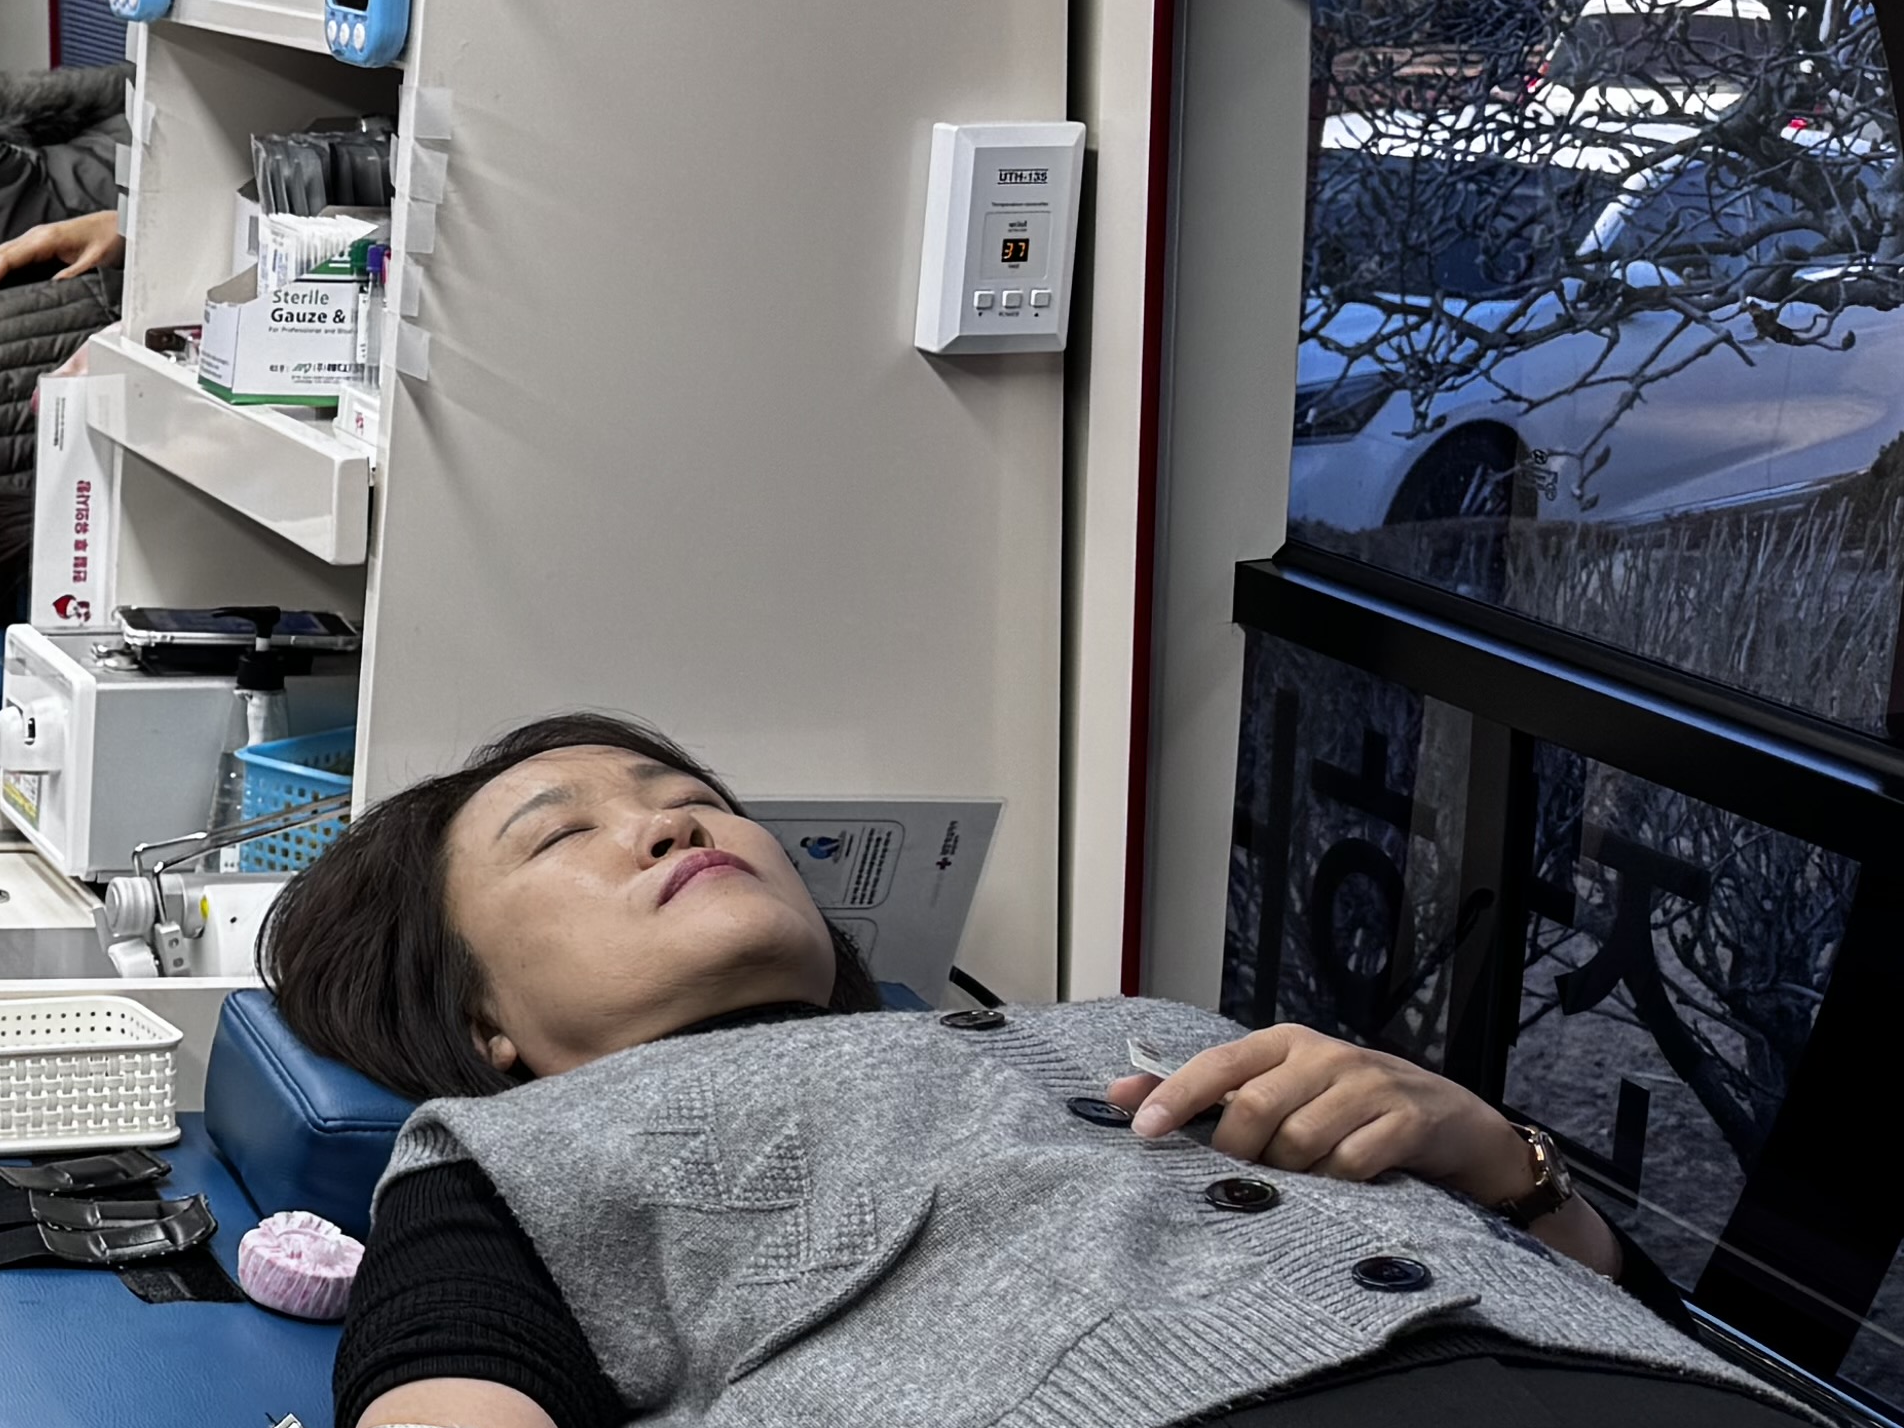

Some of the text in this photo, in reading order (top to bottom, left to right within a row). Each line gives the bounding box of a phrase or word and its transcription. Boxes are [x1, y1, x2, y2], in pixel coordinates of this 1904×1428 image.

[1003, 242, 1026, 259] 37
[272, 289, 330, 305] Sterile
[270, 310, 328, 324] Gauze
